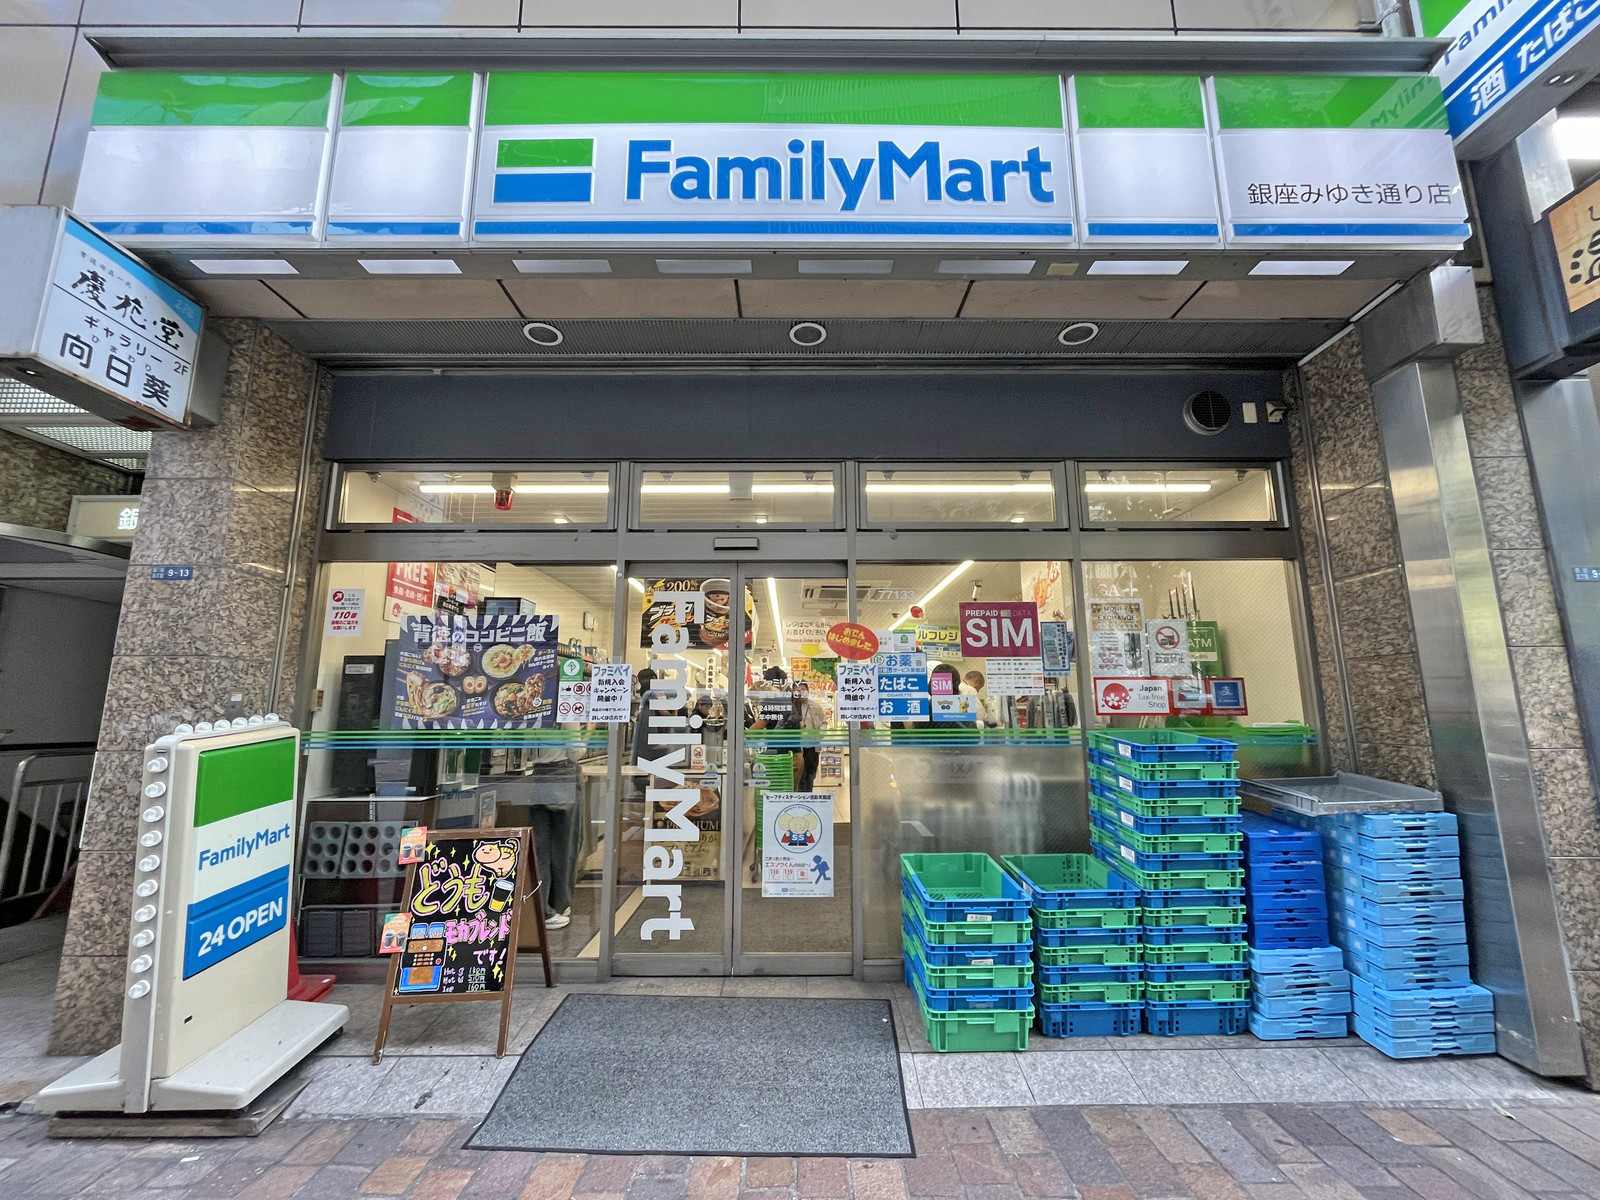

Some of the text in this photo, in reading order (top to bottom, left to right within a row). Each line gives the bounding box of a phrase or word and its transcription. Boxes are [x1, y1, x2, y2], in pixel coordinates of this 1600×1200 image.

[1470, 61, 1507, 116] 酒
[625, 137, 1055, 212] FamilyMart
[1247, 182, 1452, 206] 銀座みゆき通り店
[84, 314, 189, 376] ギャラリー 2F
[92, 335, 152, 372] ひまわり
[60, 332, 171, 408] 向日葵
[167, 568, 190, 577] 9-13
[965, 609, 1032, 617] PREPAID DATA
[786, 621, 832, 629] レジはこちらから
[966, 617, 1034, 648] SIM
[1187, 638, 1212, 648] ATM
[886, 654, 912, 667] お薬
[594, 665, 631, 677] ファミペイ
[839, 664, 877, 676] ファミペイ
[598, 678, 626, 686] 新規入会
[844, 677, 872, 685] 新規入会
[879, 676, 919, 691] たばこ
[931, 679, 953, 691] SIM
[759, 704, 793, 712] 24時間営業
[1148, 701, 1167, 709] Shop
[759, 713, 784, 721] 年中無休
[637, 591, 706, 941] FamilyMart
[666, 820, 719, 831] PRIUM
[198, 823, 291, 871] FamilyMart
[411, 856, 490, 917] どうも
[197, 896, 283, 958] 24 OPEN
[445, 909, 514, 945] モカブレンド
[443, 967, 456, 976] Hot
[442, 985, 455, 993] Ice
